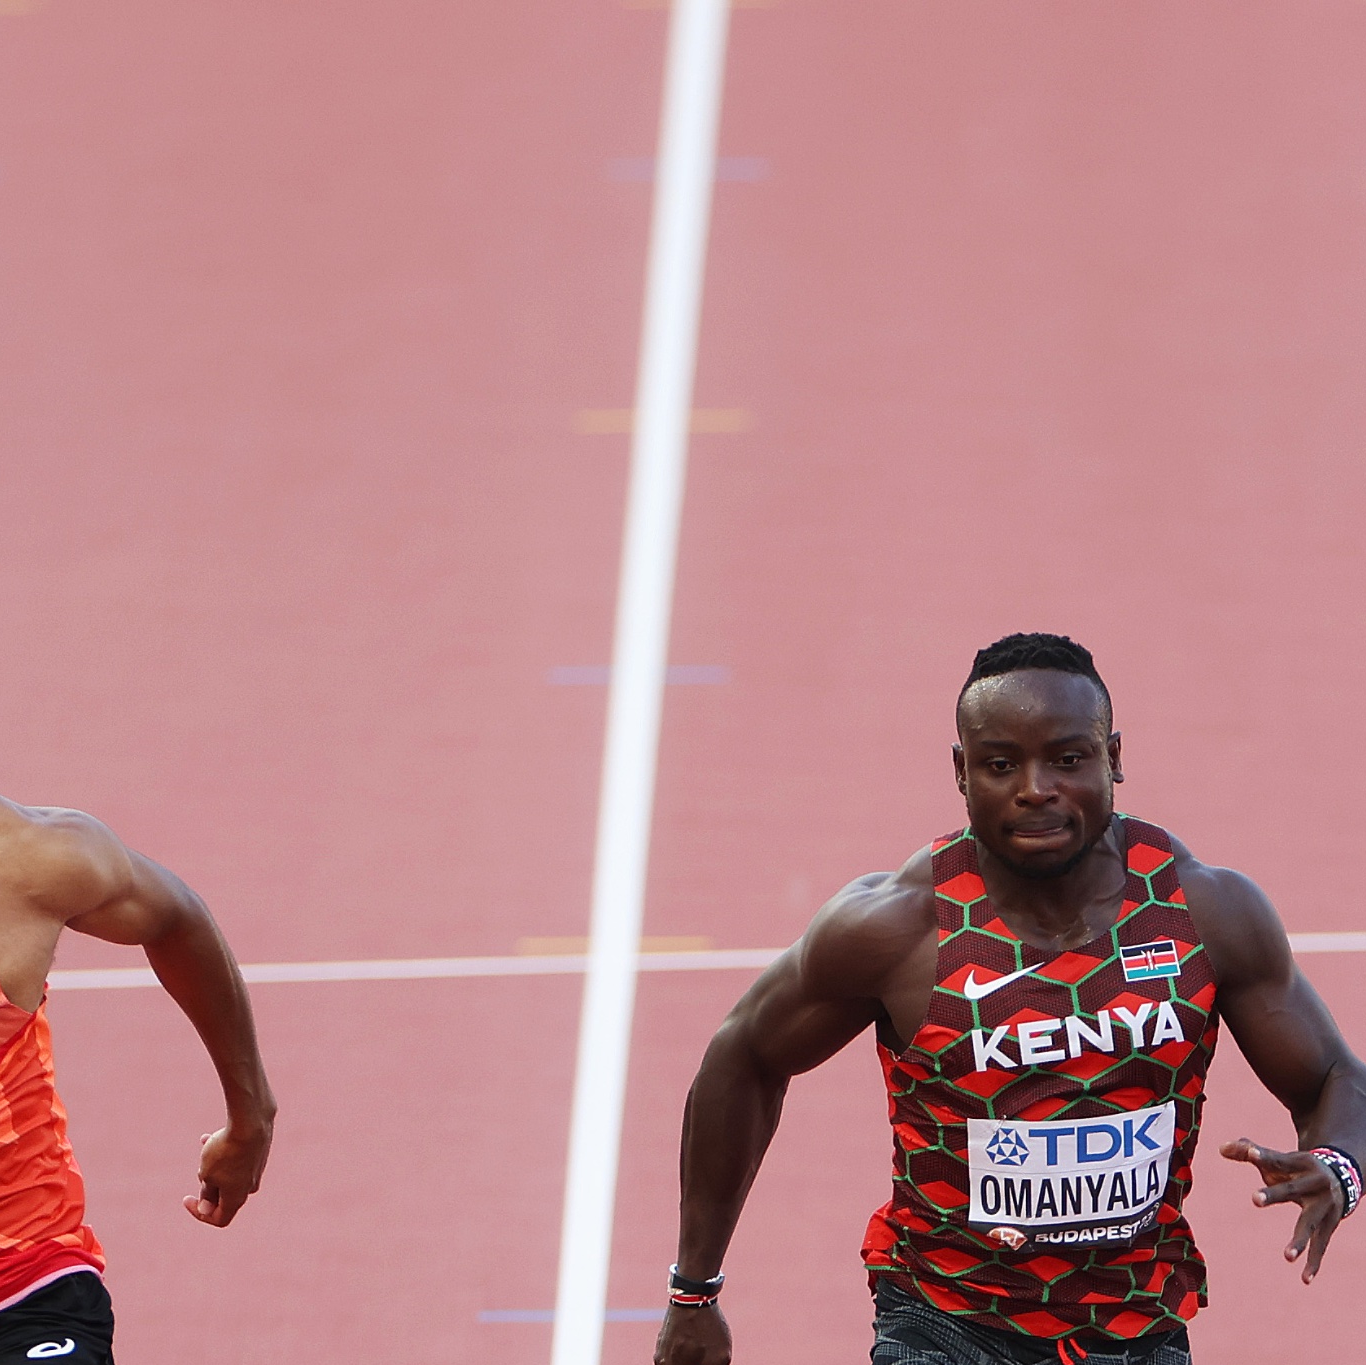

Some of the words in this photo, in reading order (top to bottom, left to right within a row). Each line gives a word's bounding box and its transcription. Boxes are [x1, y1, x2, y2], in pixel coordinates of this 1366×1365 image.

[971, 1001, 1185, 1072] KENYA
[1029, 1112, 1163, 1167] TDK
[980, 1160, 1160, 1219] OMANYALA
[1035, 1221, 1140, 1244] BUDAPEST
